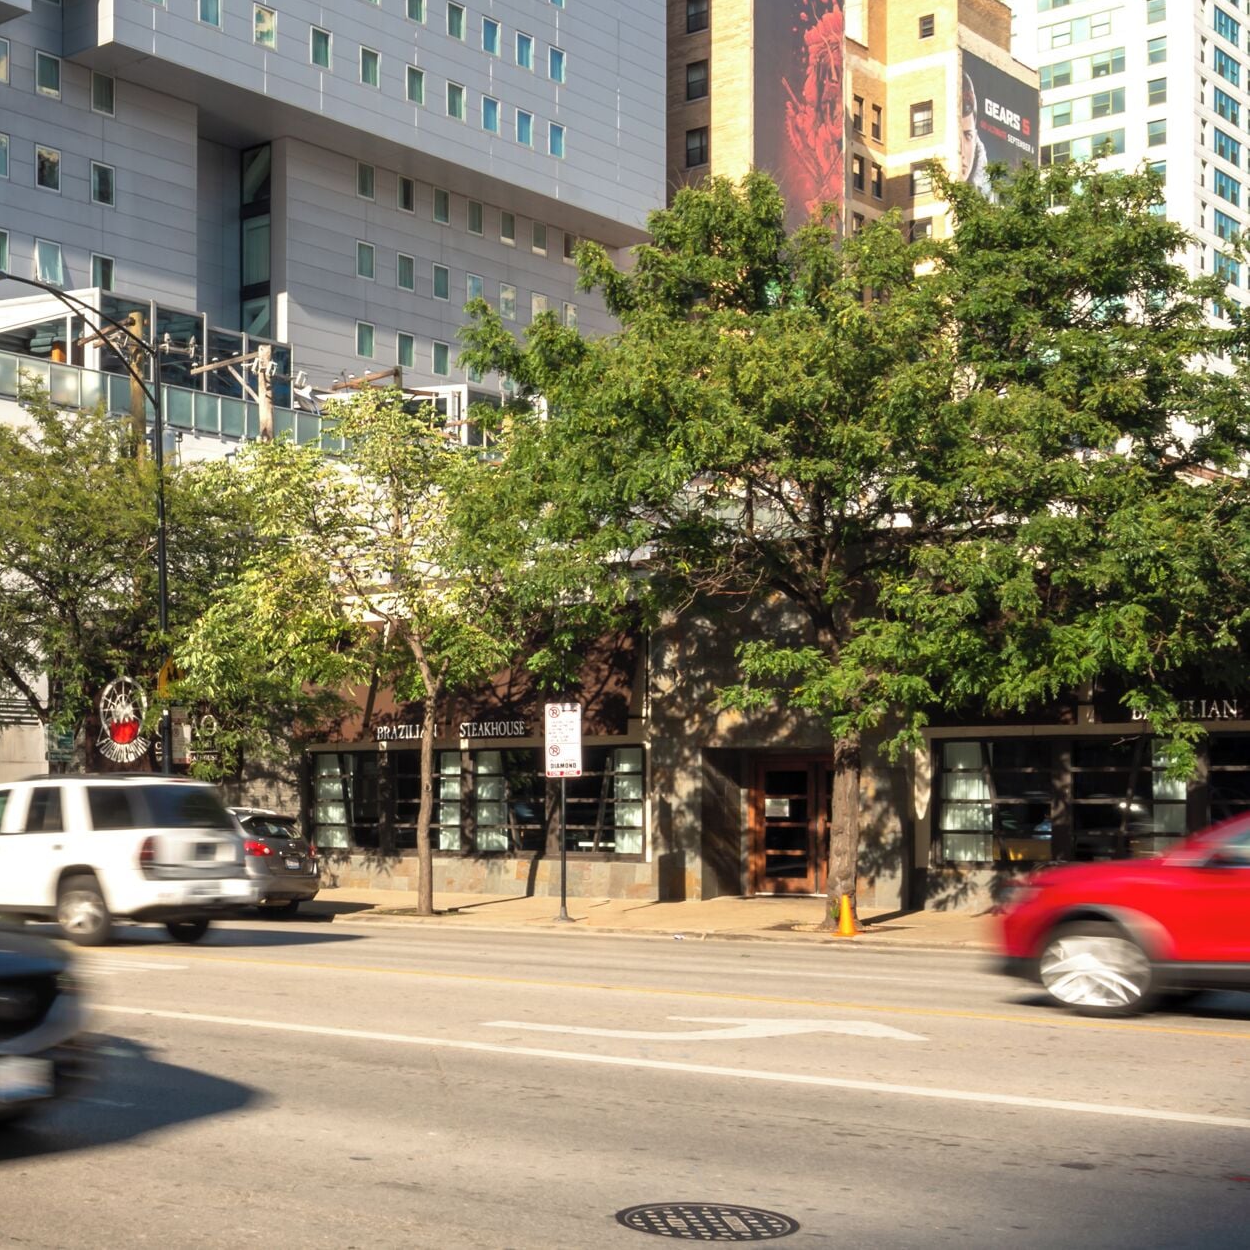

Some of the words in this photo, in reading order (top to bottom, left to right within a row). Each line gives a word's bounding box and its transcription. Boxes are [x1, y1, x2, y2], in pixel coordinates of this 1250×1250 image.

[984, 97, 1021, 131] GEARS
[1021, 117, 1031, 136] 5
[1007, 133, 1031, 153] SEPTEMBER
[1132, 698, 1238, 720] BRILIAN
[459, 720, 525, 738] STEAKHOUSE
